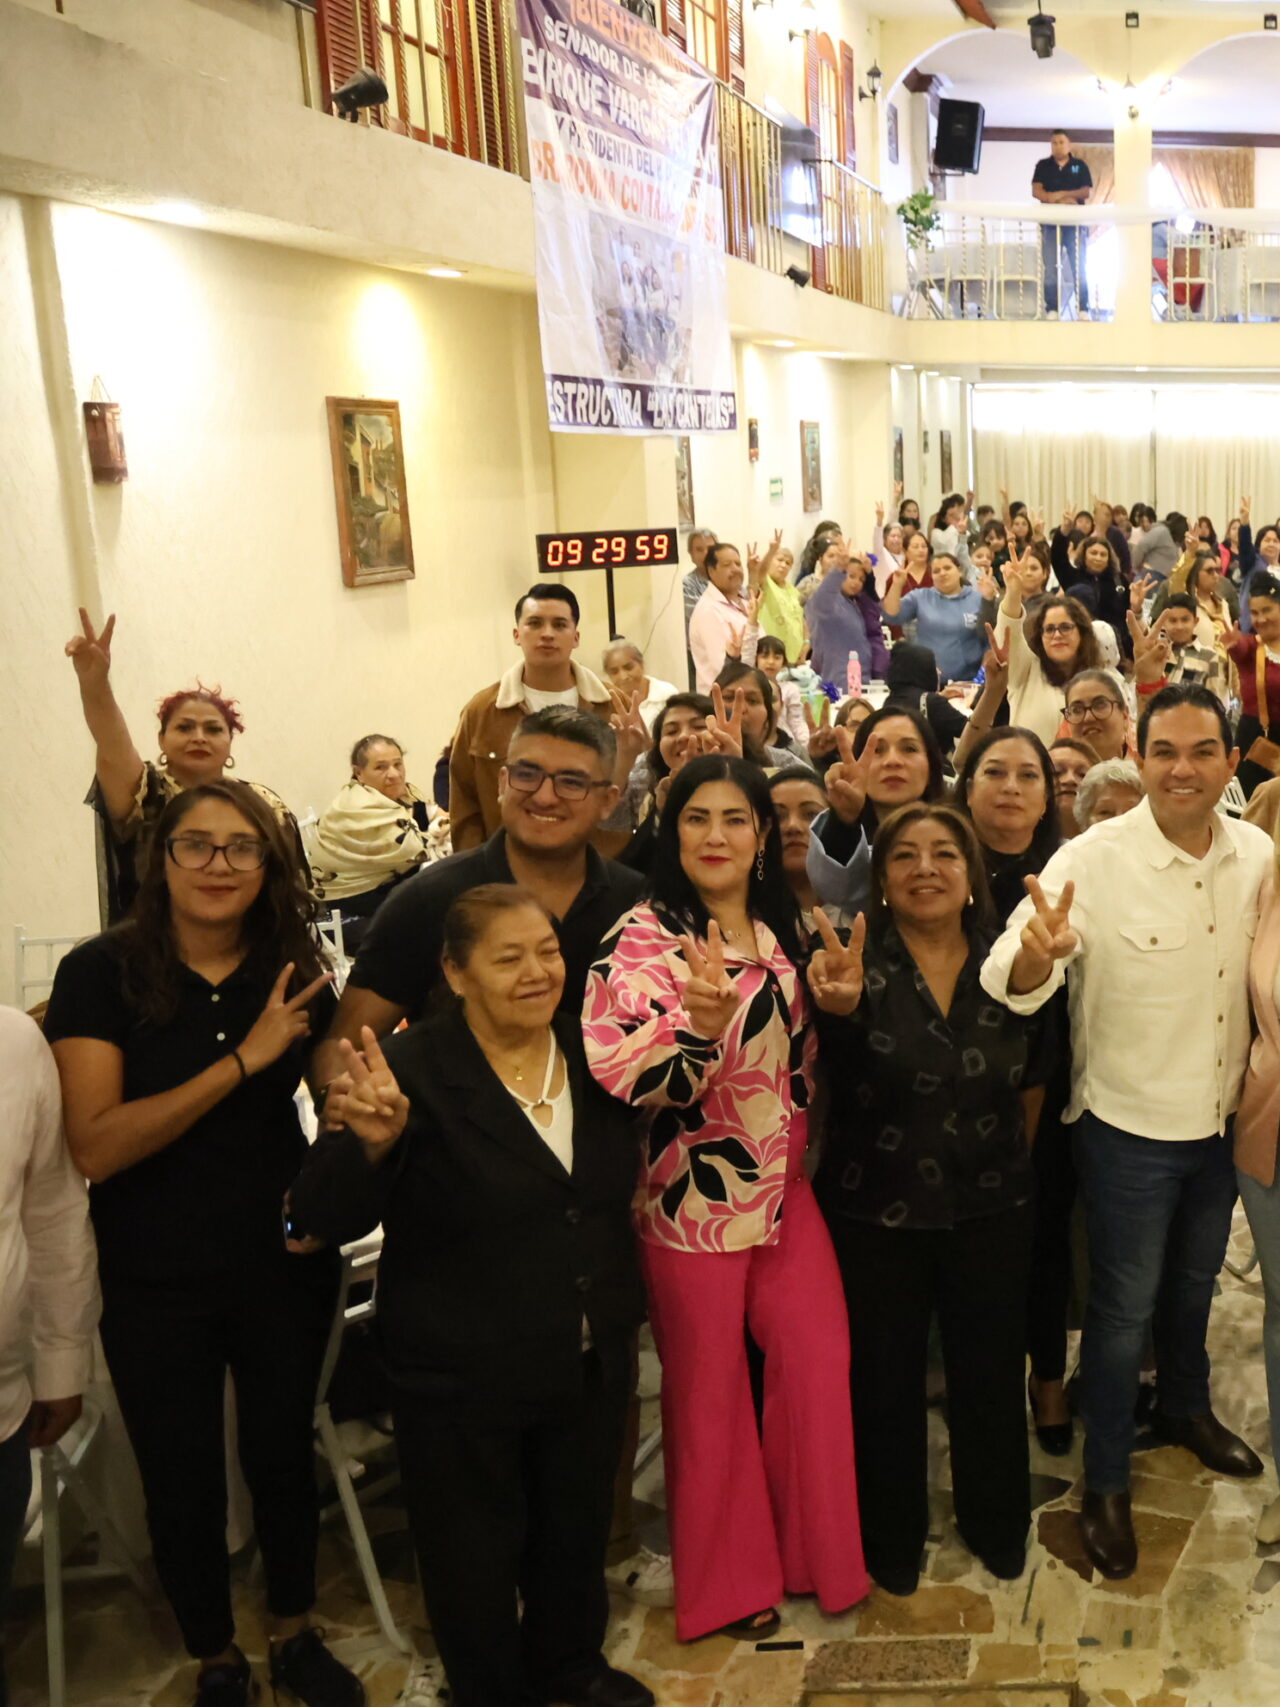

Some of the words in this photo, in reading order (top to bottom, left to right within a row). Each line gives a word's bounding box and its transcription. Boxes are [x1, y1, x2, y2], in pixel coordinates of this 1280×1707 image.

[544, 15, 620, 75] SENADOR
[622, 56, 642, 85] DE
[547, 539, 582, 566] 09
[592, 537, 626, 563] 29
[636, 534, 668, 559] 59
